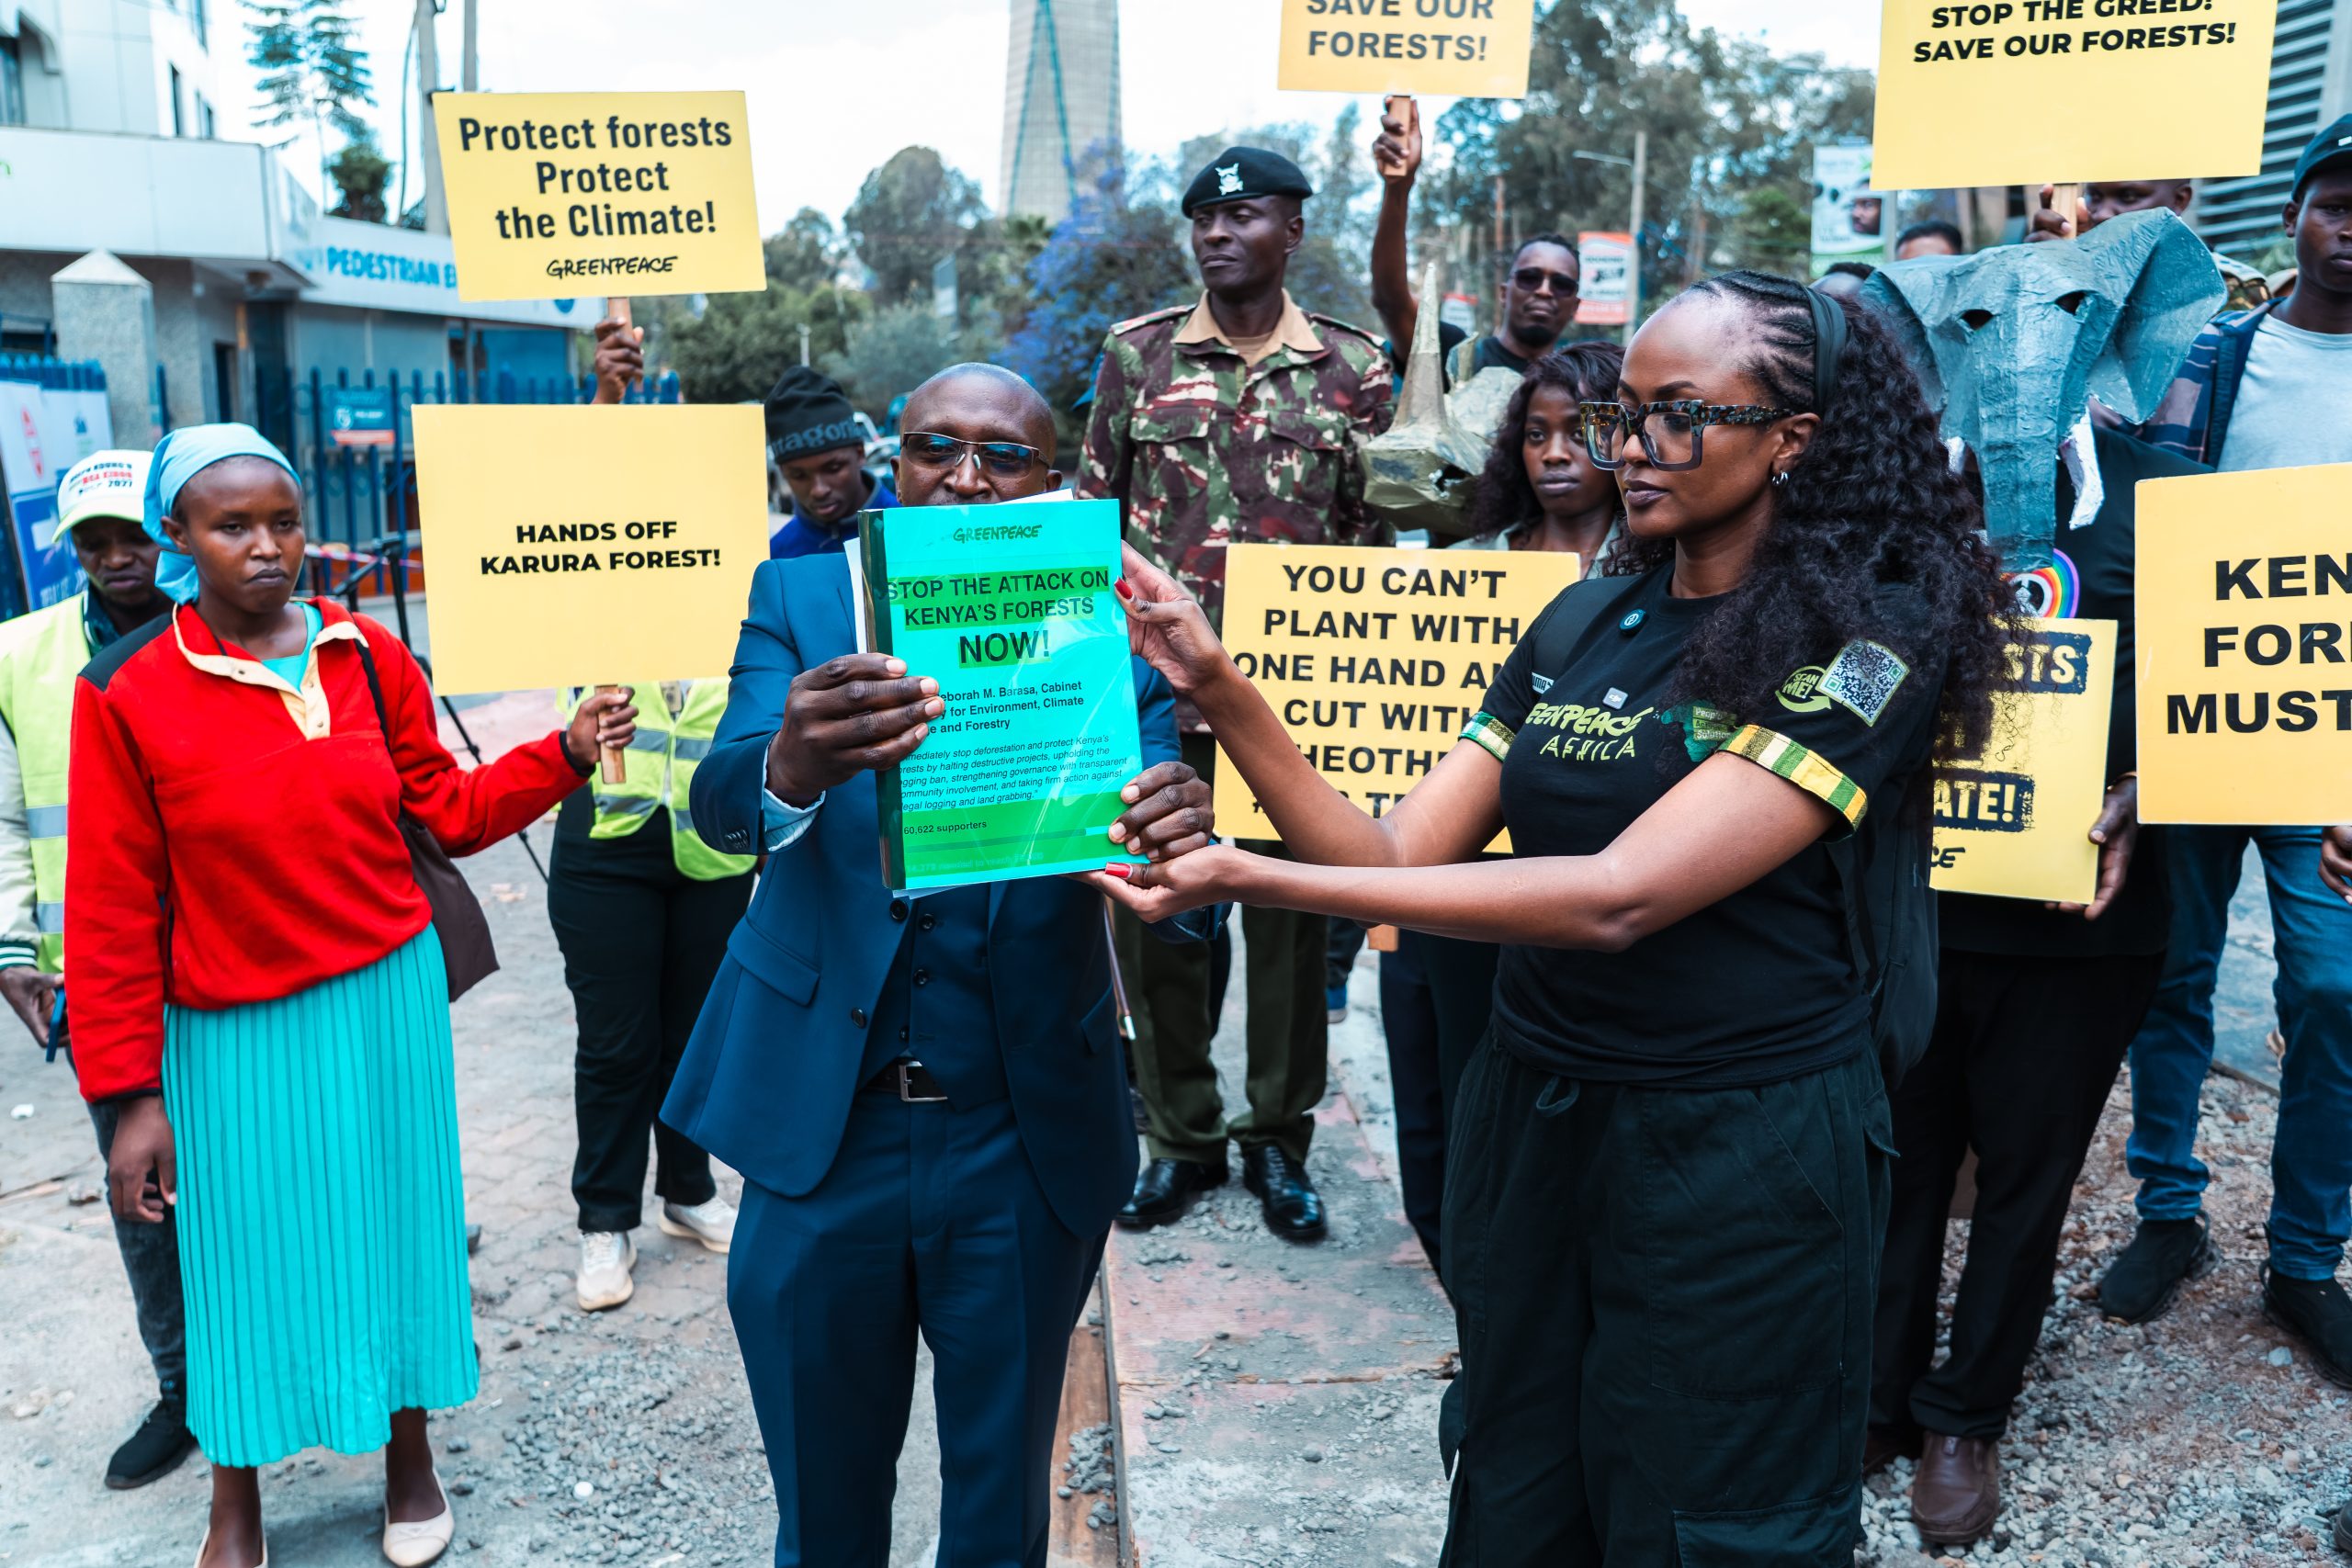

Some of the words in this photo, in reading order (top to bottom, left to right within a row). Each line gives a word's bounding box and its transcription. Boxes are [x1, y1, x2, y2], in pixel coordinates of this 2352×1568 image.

[1416, 0, 1493, 19] OUR
[1931, 3, 2013, 28] STOP
[2023, 0, 2084, 22] THE
[1307, 30, 1487, 62] FORESTS!
[1913, 37, 1994, 62] SAVE
[2004, 33, 2071, 57] OUR
[2081, 22, 2236, 52] FORESTS!
[459, 118, 596, 151] Protect
[607, 115, 732, 148] forests
[537, 162, 670, 194] Protect
[495, 207, 556, 239] the
[569, 201, 717, 236] Climate!
[327, 246, 440, 286] PEDESTRIAN
[547, 256, 679, 279] GREENPEACE
[516, 522, 617, 543] HANDS
[625, 521, 677, 540] OFF
[953, 525, 1043, 544] GREENPEACE
[481, 553, 602, 575] KARURA
[609, 549, 721, 570] FOREST!
[950, 577, 992, 596] THE
[999, 572, 1075, 593] ATTACK
[1080, 570, 1110, 589] ON
[1283, 564, 1365, 594] YOU
[1382, 567, 1507, 599] CAN'T
[905, 602, 997, 626] KENYA'S
[1003, 597, 1094, 620] FORESTS
[1264, 609, 1397, 640] PLANT
[1411, 614, 1520, 645] WITH
[959, 629, 1050, 664] NOW!
[2203, 621, 2352, 668] FOR
[1234, 652, 1314, 682] ONE
[1329, 656, 1445, 687] HAND
[1793, 673, 1820, 686] SCAN
[937, 689, 979, 702] eborah
[983, 689, 996, 699] M.
[1000, 684, 1039, 698] Barasa,
[1041, 681, 1082, 694] Cabinet
[1782, 681, 1814, 699] ME!
[950, 705, 967, 716] for
[970, 700, 1041, 716] Environment,
[1043, 695, 1084, 708] Climate
[1284, 699, 1366, 729] CUT
[2166, 689, 2352, 735] MUST
[940, 721, 962, 733] and
[966, 717, 1011, 732] Forestry
[953, 749, 972, 759] stop
[974, 743, 1025, 756] deforestation
[1027, 741, 1043, 750] and
[1044, 738, 1074, 750] protect
[1076, 734, 1110, 746] Kenya's
[1540, 735, 1635, 761] AFRICA
[927, 762, 938, 773] by
[940, 760, 969, 772] halting
[970, 757, 1015, 769] destructive
[1016, 753, 1050, 765] projects,
[1053, 748, 1094, 761] upholding
[1096, 747, 1110, 756] the
[930, 774, 949, 784] ban,
[951, 770, 1008, 784] strengthening
[1010, 763, 1057, 778] governance
[1059, 761, 1077, 772] with
[1079, 756, 1127, 770] transparent
[946, 782, 999, 795] involvement,
[1001, 779, 1016, 789] and
[1018, 776, 1044, 788] taking
[1045, 774, 1061, 784] firm
[1064, 773, 1089, 784] action
[1091, 769, 1123, 782] against
[924, 798, 956, 810] logging
[958, 797, 976, 807] and
[978, 795, 995, 804] land
[904, 825, 934, 835] 60,622
[936, 820, 988, 833] supporters
